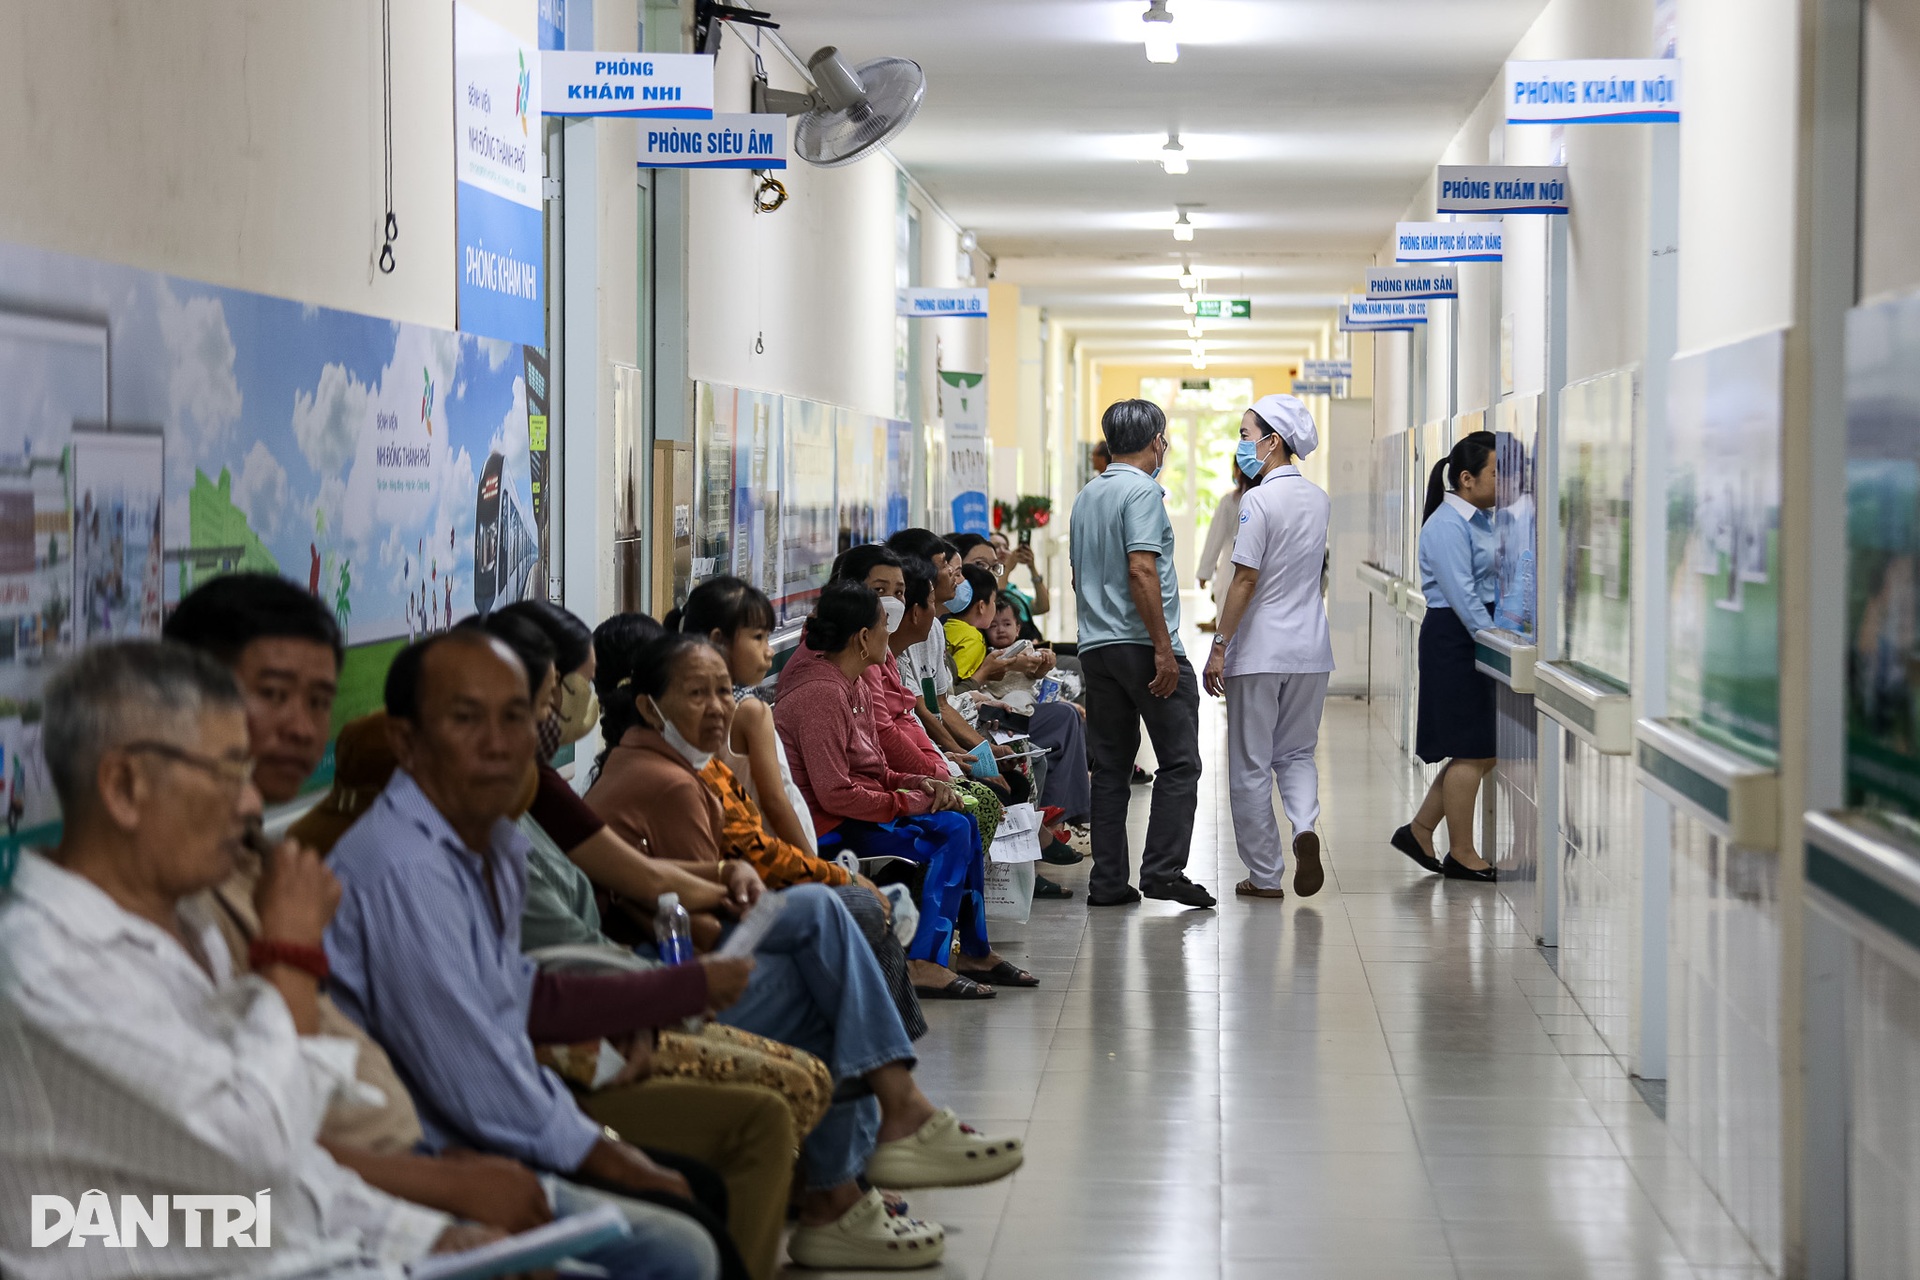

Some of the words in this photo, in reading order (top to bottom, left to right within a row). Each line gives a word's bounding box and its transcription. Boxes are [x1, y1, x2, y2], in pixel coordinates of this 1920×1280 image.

[595, 58, 653, 76] PHÒNG
[568, 83, 634, 100] KHÁM
[643, 86, 681, 101] NHI
[1514, 75, 1575, 104] PHÒNG
[1582, 75, 1635, 103] KHÁM
[1642, 75, 1674, 108] NỘI
[479, 126, 495, 161] ĐỒNG
[514, 143, 526, 173] PHỐ
[648, 127, 702, 154] PHÒNG
[707, 128, 743, 154] SIÊU
[748, 128, 773, 154] ÂM
[1443, 177, 1490, 199] PHÒNG
[1494, 178, 1534, 200] KHÁM
[1540, 179, 1564, 204] NỘI
[1400, 232, 1419, 250] PHÒNG
[1421, 232, 1438, 250] KHÁM
[1439, 235, 1454, 253] PHỤC
[466, 238, 497, 291] PHÒNG
[497, 248, 521, 297] KHÁM
[522, 262, 537, 301] NHI
[1371, 276, 1402, 292] PHÒNG
[1405, 276, 1431, 291] KHÁM
[1434, 274, 1452, 290] SẢN
[1352, 301, 1367, 315] PHÒNG
[1369, 300, 1381, 315] KHÁM
[1393, 303, 1404, 314] KHOA
[377, 408, 388, 434] BỆNH
[387, 441, 402, 468] ĐỒNG
[420, 443, 431, 468] PHỐ
